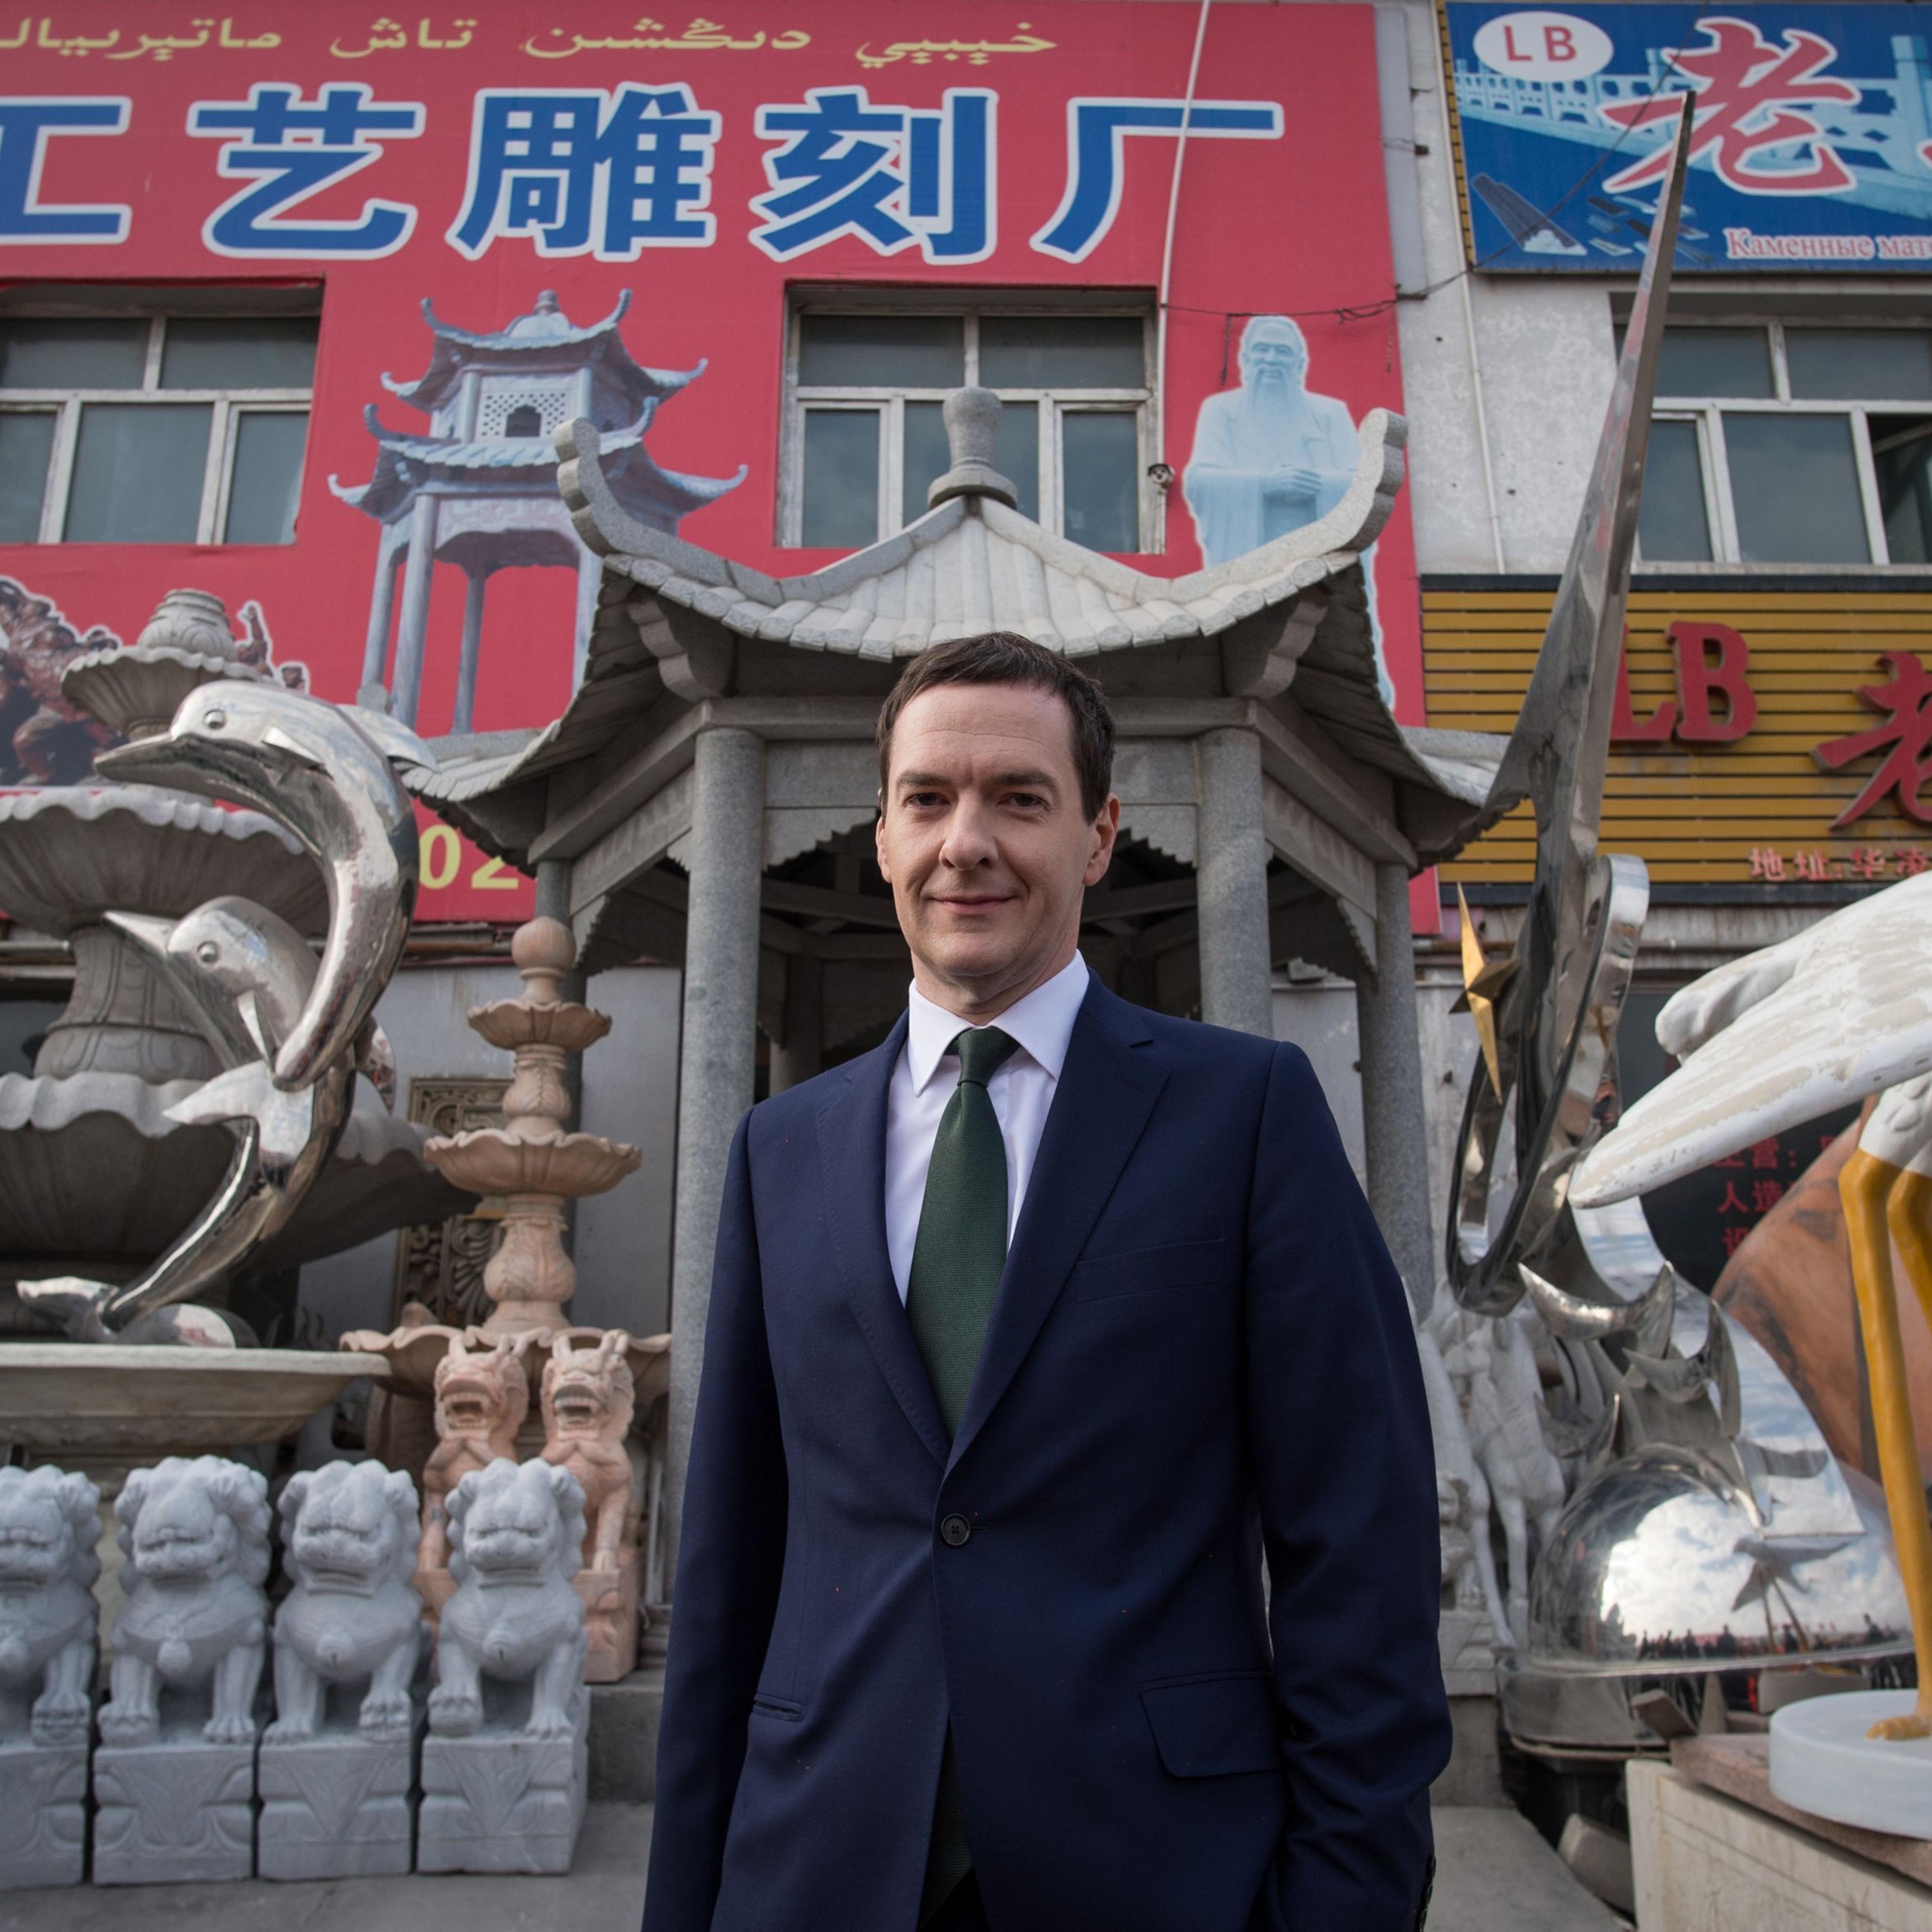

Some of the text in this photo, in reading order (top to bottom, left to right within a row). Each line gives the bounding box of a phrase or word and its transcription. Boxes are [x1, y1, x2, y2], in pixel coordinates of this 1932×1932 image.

[330, 17, 477, 58] تاش
[1598, 17, 1932, 195] 老
[0, 82, 1284, 266] 工艺雕刻厂
[1723, 228, 1932, 260] Каменные мат
[1610, 620, 1758, 741] LB
